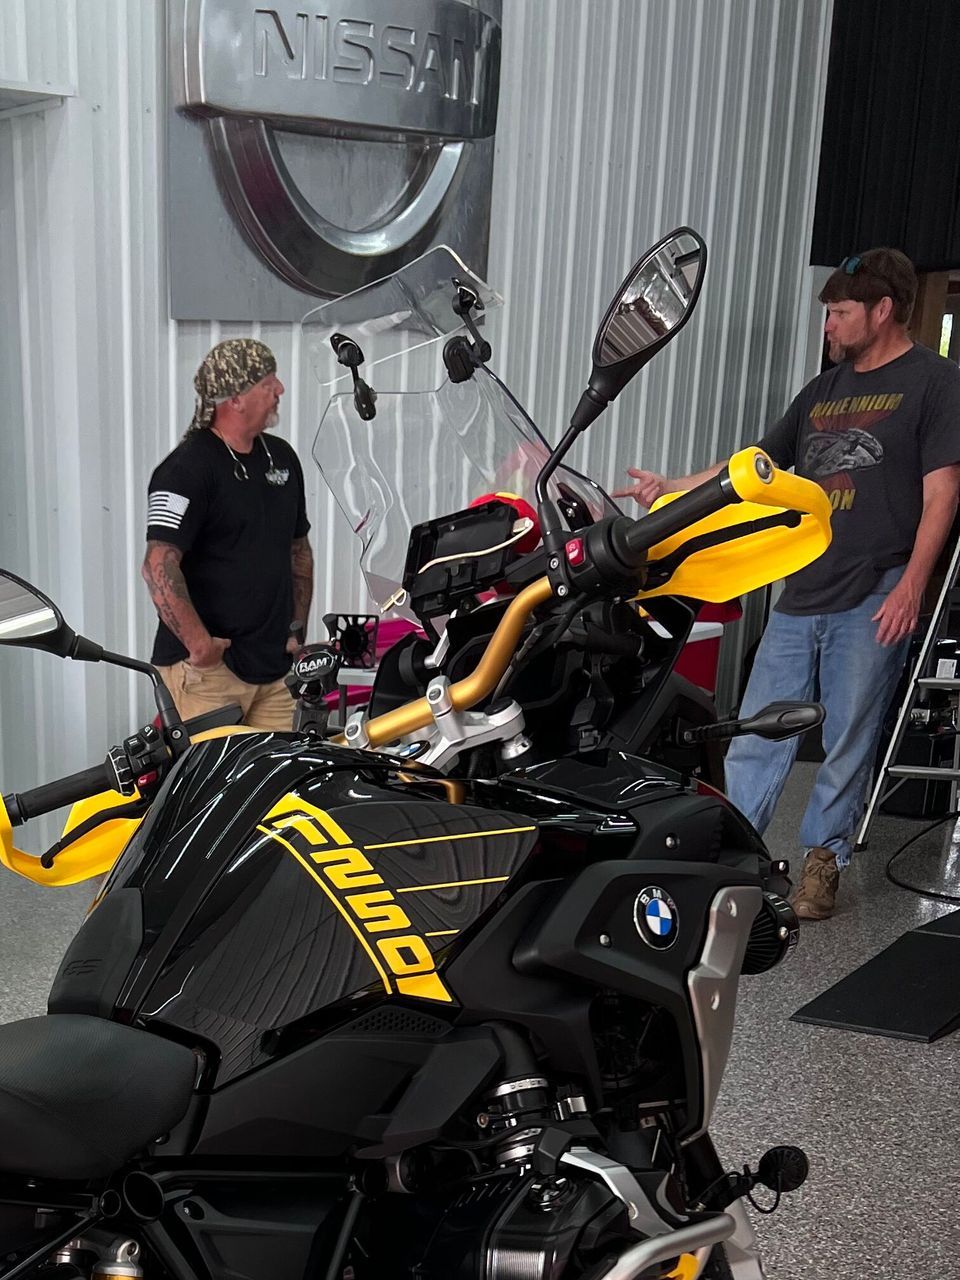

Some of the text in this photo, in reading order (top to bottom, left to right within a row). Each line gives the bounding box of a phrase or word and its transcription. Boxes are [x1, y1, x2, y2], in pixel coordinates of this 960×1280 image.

[253, 8, 482, 107] NISSAN
[809, 393, 904, 418] MILLENNIUM
[298, 657, 328, 672] RAM
